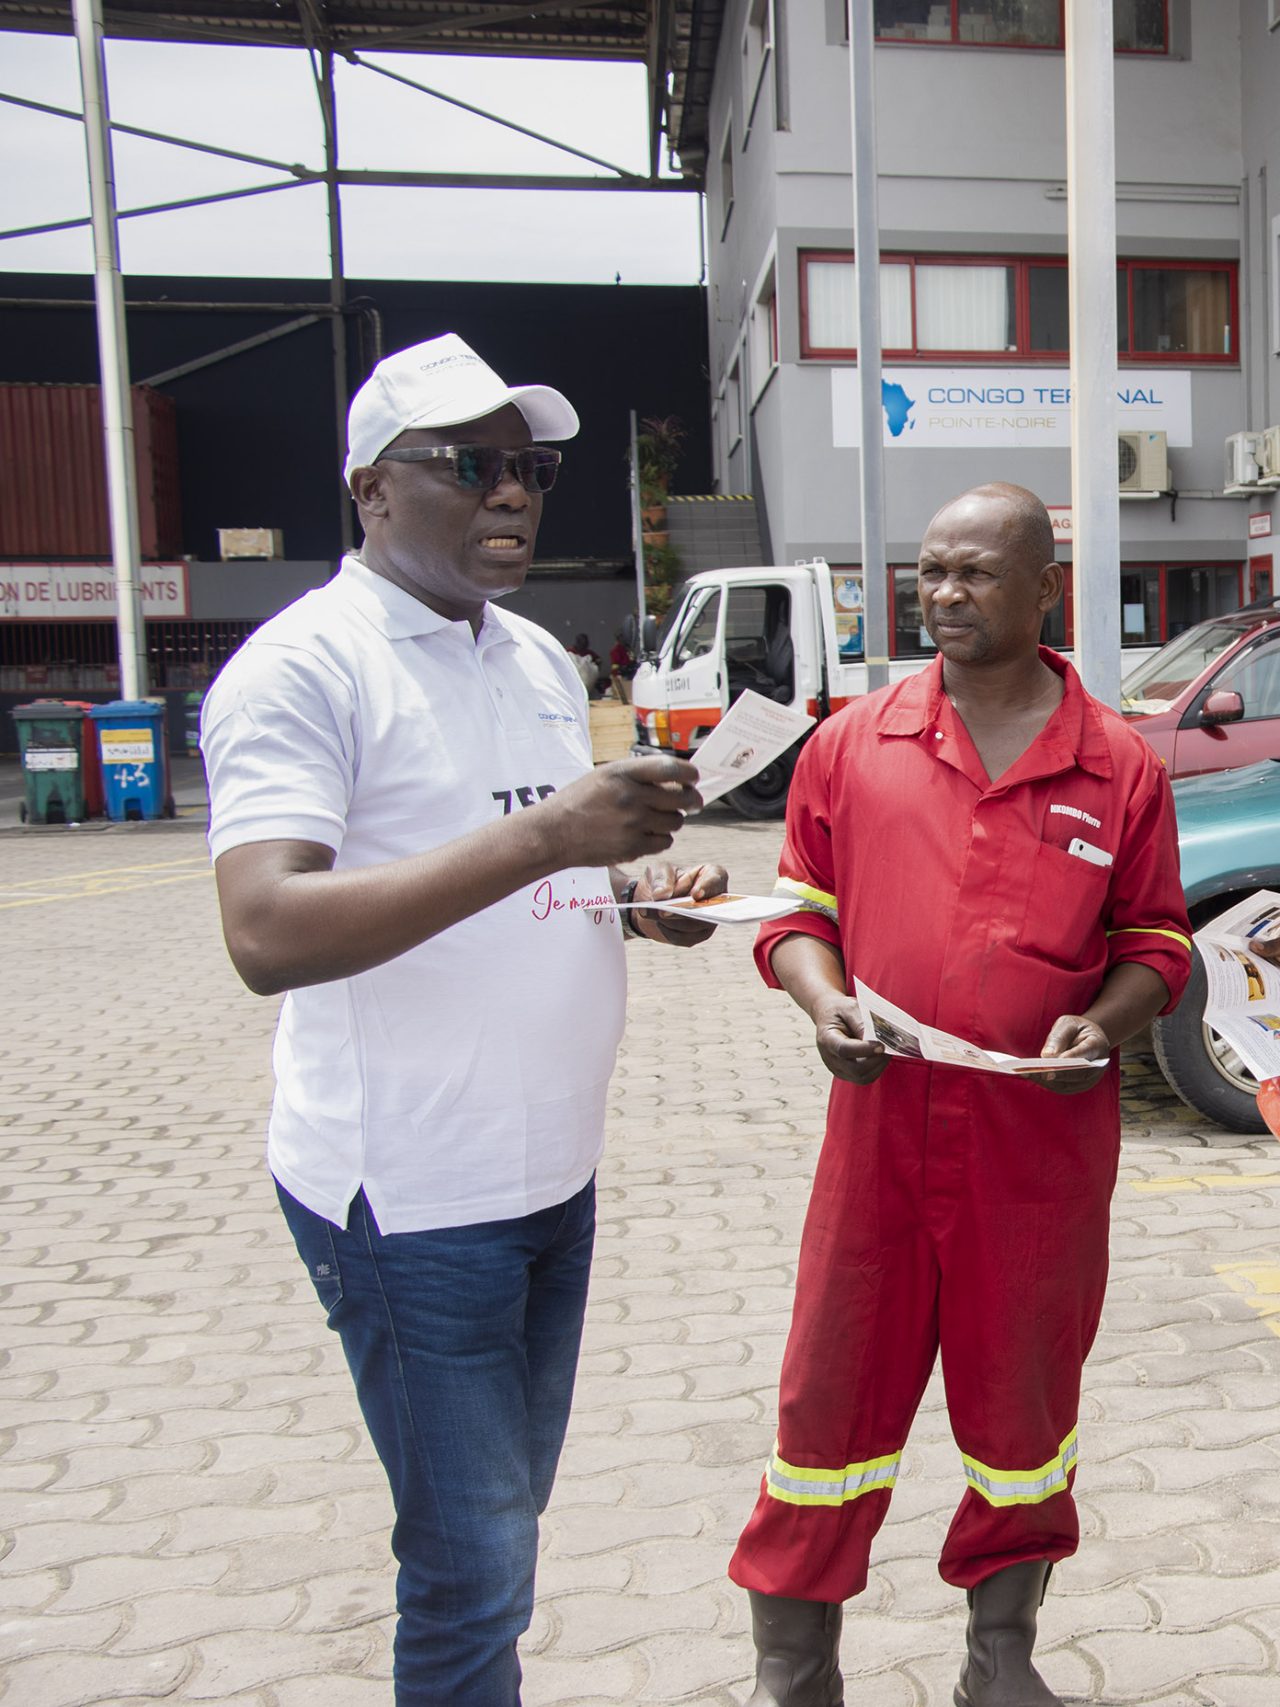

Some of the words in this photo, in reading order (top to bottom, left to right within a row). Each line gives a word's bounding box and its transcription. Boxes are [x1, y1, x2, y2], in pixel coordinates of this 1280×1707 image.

[927, 387, 1026, 405] CONGO
[928, 415, 1058, 430] POINTE-NOIRE
[25, 582, 49, 602] DE
[531, 880, 565, 921] Je
